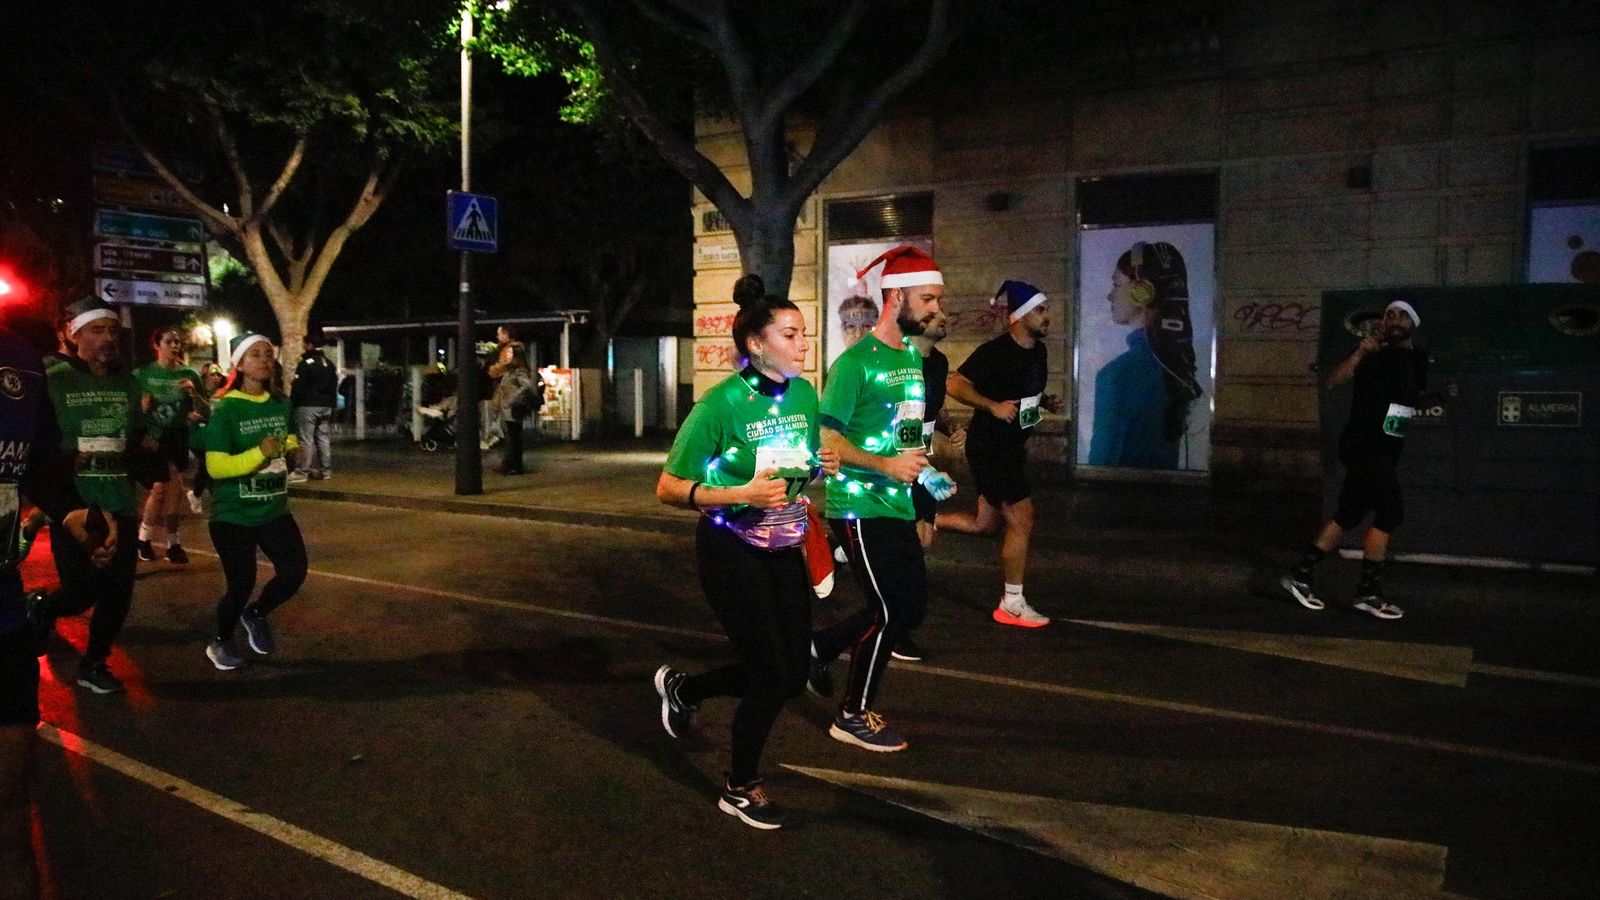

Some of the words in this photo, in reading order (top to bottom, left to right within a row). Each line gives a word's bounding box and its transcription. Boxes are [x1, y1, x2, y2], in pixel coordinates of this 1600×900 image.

[763, 418, 777, 428] SAN
[747, 427, 774, 438] CIUDAD
[775, 425, 785, 433] DE
